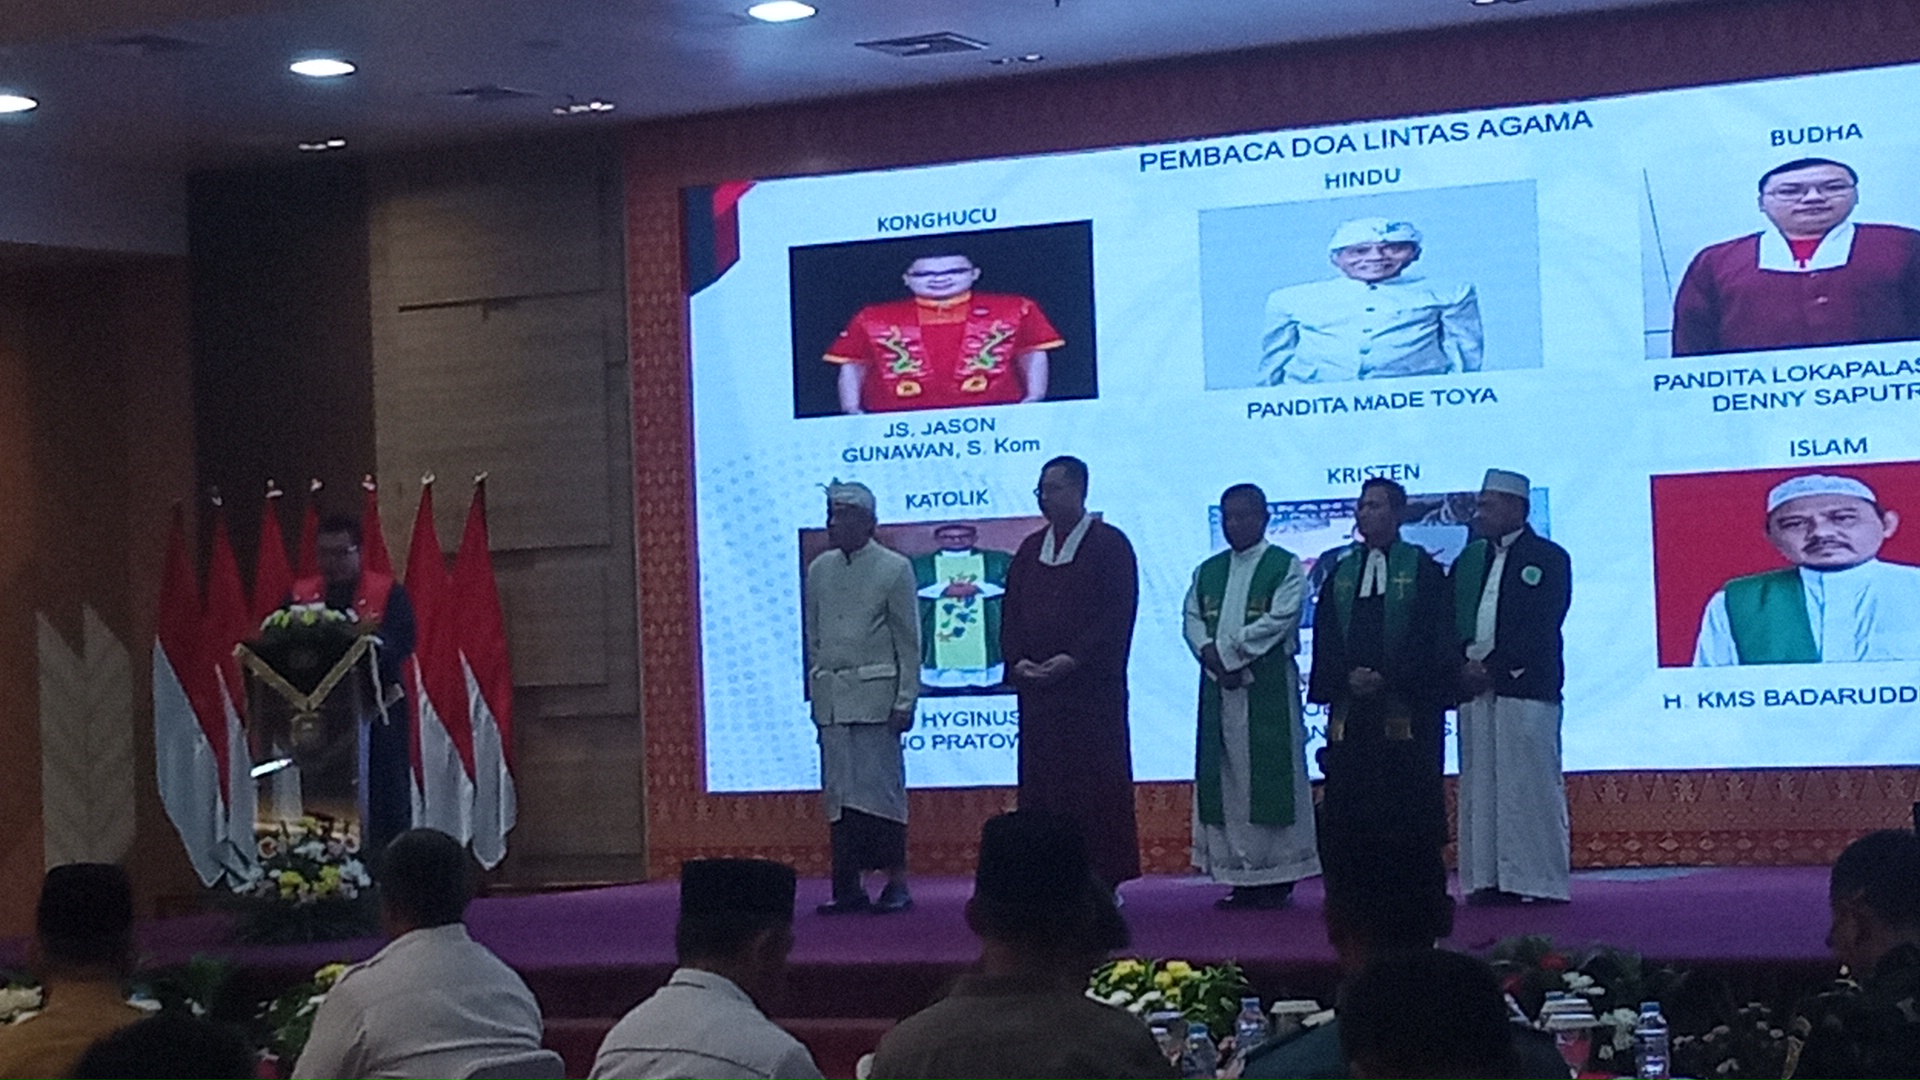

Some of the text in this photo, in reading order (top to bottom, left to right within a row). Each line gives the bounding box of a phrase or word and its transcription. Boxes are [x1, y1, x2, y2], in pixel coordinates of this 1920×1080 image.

[1140, 110, 1593, 172] PEMBACA DOA LINTAS AGAMA
[1771, 123, 1863, 147] BUDHA
[1325, 169, 1401, 189] HINDU
[877, 208, 997, 232] KONGHUCU
[1653, 368, 1766, 391] PANDITA
[1247, 388, 1498, 419] PANDITA MADE TOYA
[1713, 390, 1807, 412] DENNY
[883, 417, 996, 438] JS. JASON
[842, 442, 961, 463] GUNAWAN,
[994, 437, 1041, 453] Kom
[1790, 437, 1868, 457] ISLAM
[1327, 464, 1420, 484] KRISTEN
[906, 489, 989, 510] KATOLIK
[1698, 690, 1756, 709] KMS
[922, 710, 1019, 728] HYGINUS
